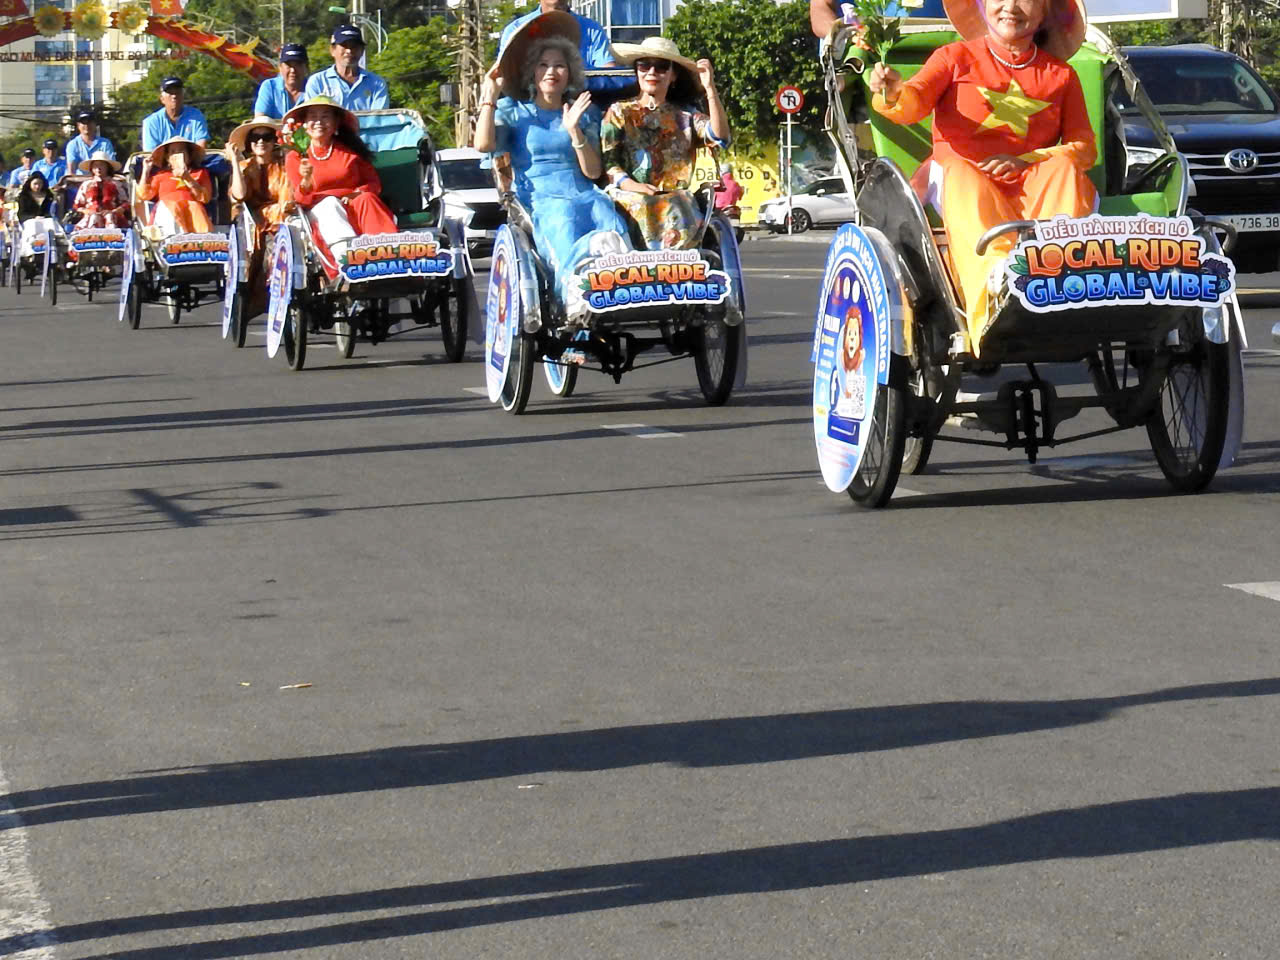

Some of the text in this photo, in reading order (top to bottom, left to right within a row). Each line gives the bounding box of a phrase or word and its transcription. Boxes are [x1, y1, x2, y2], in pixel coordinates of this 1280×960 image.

[1083, 219, 1125, 238] HÀNH
[1129, 218, 1165, 236] XÍCH
[1168, 220, 1189, 237] LÔ
[346, 243, 437, 265] LOCAL RIDE
[1025, 238, 1201, 276] LOCAL RIDE
[346, 258, 447, 280] GLOBAL VIBE
[588, 263, 706, 291] LOCAL RIDE
[589, 283, 721, 309] GLOBAL VIBE
[1026, 271, 1219, 306] GLOBAL VIBE
[877, 306, 887, 373] TRANG
